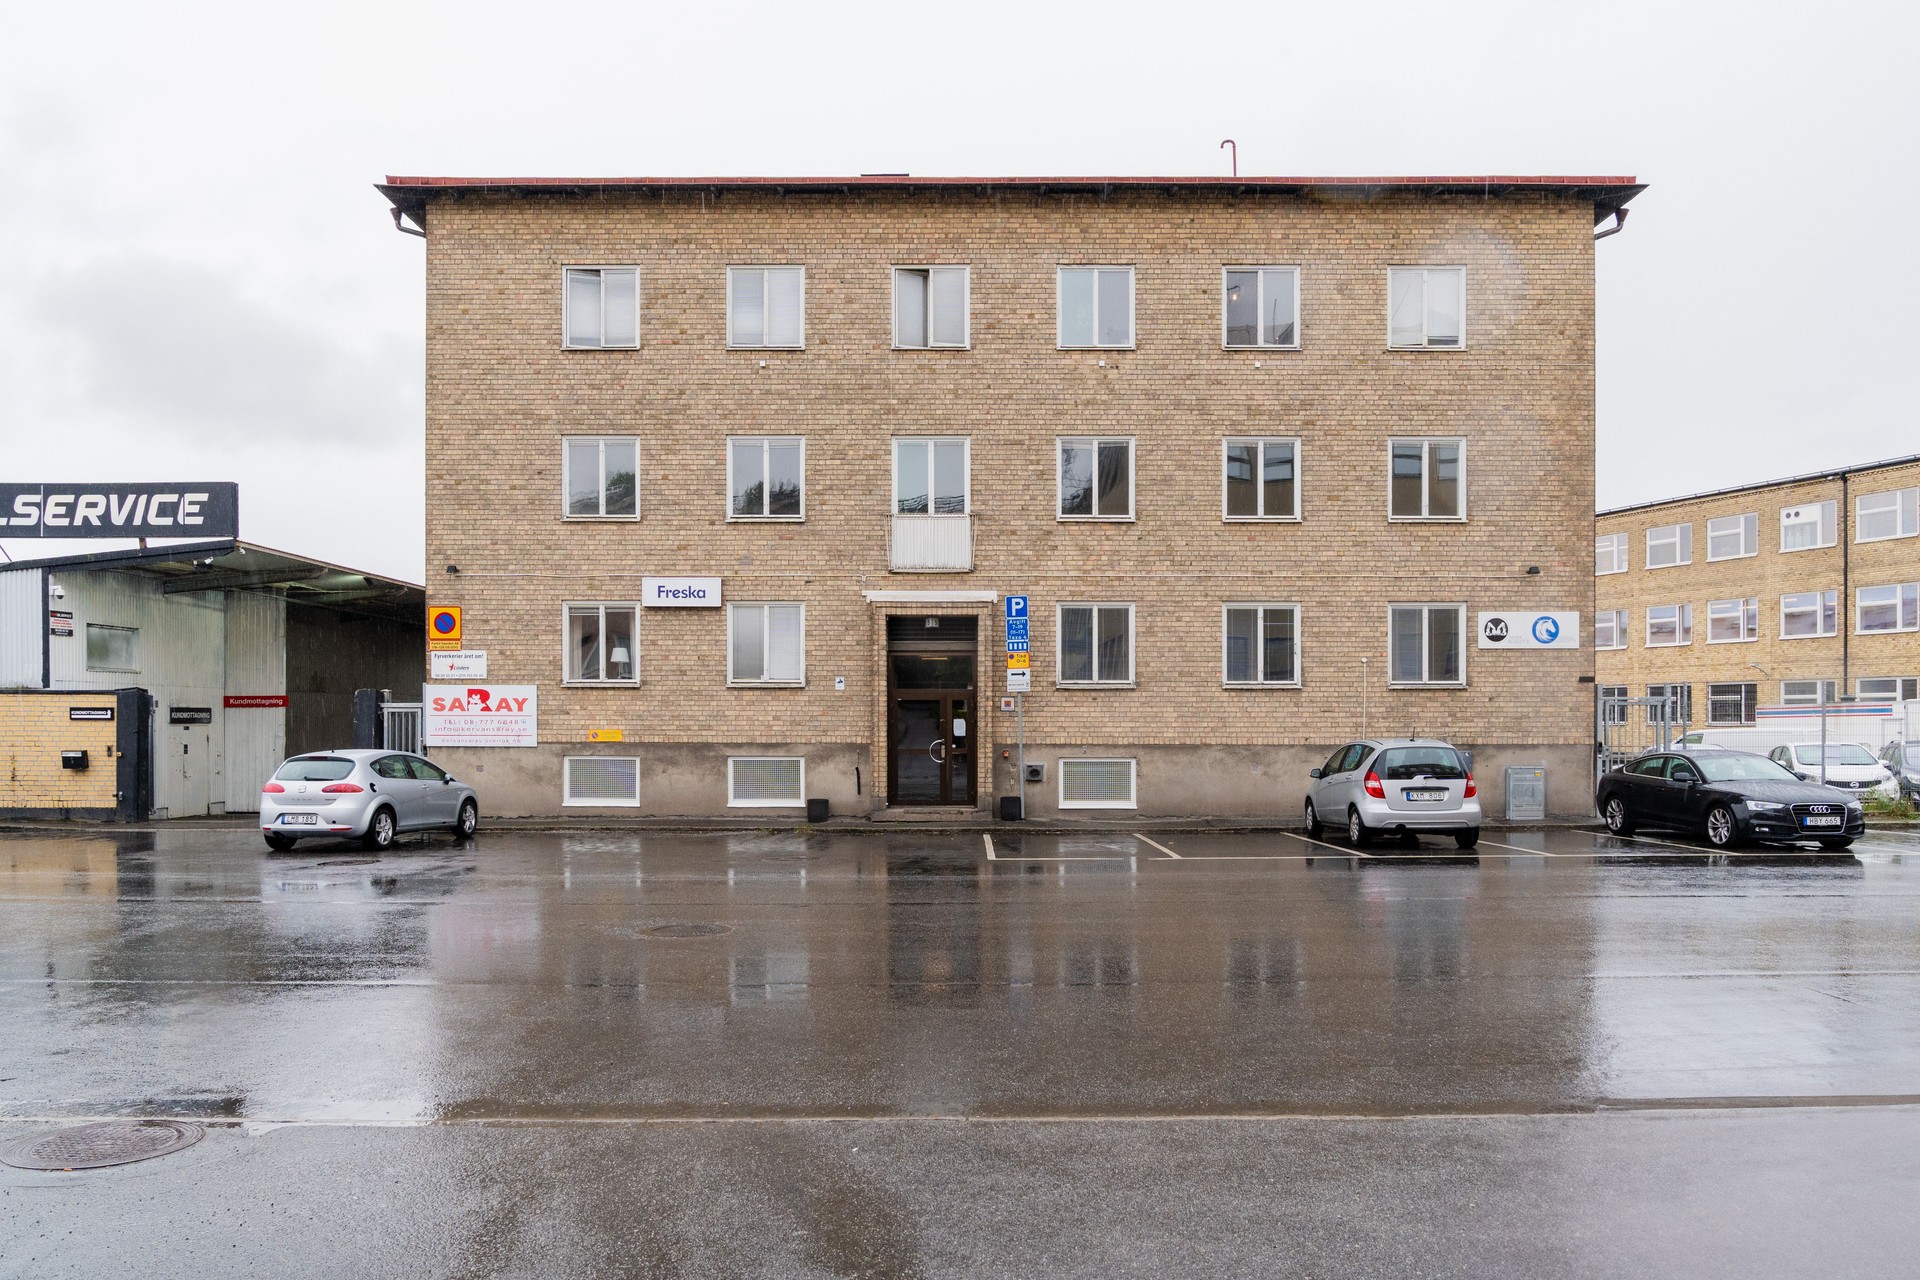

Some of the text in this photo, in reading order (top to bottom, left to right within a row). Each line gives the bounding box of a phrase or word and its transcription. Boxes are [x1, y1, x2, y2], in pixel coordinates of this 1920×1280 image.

[657, 585, 706, 599] Freska
[1011, 598, 1025, 616] P
[432, 689, 529, 712] SARAY
